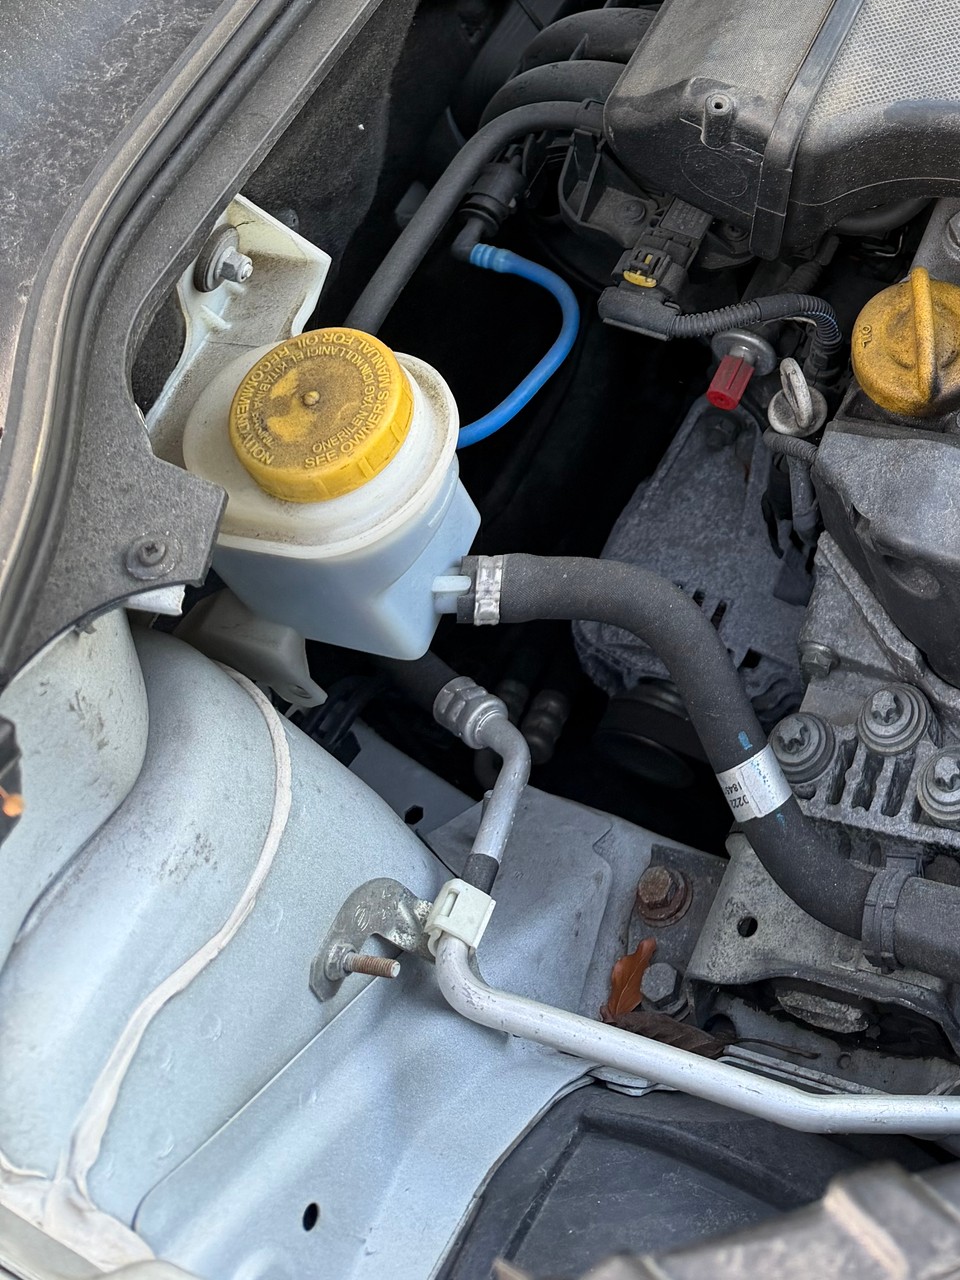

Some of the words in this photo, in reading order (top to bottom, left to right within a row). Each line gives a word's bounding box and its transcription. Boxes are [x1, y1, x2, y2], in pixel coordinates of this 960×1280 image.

[298, 335, 319, 348] OIL
[322, 333, 355, 345] FOR
[862, 324, 872, 348] OIL
[358, 338, 391, 387] MANUAL
[236, 347, 290, 465] RECOMMENDATION
[341, 390, 389, 453] OWNER'S
[304, 450, 338, 468] SEE
